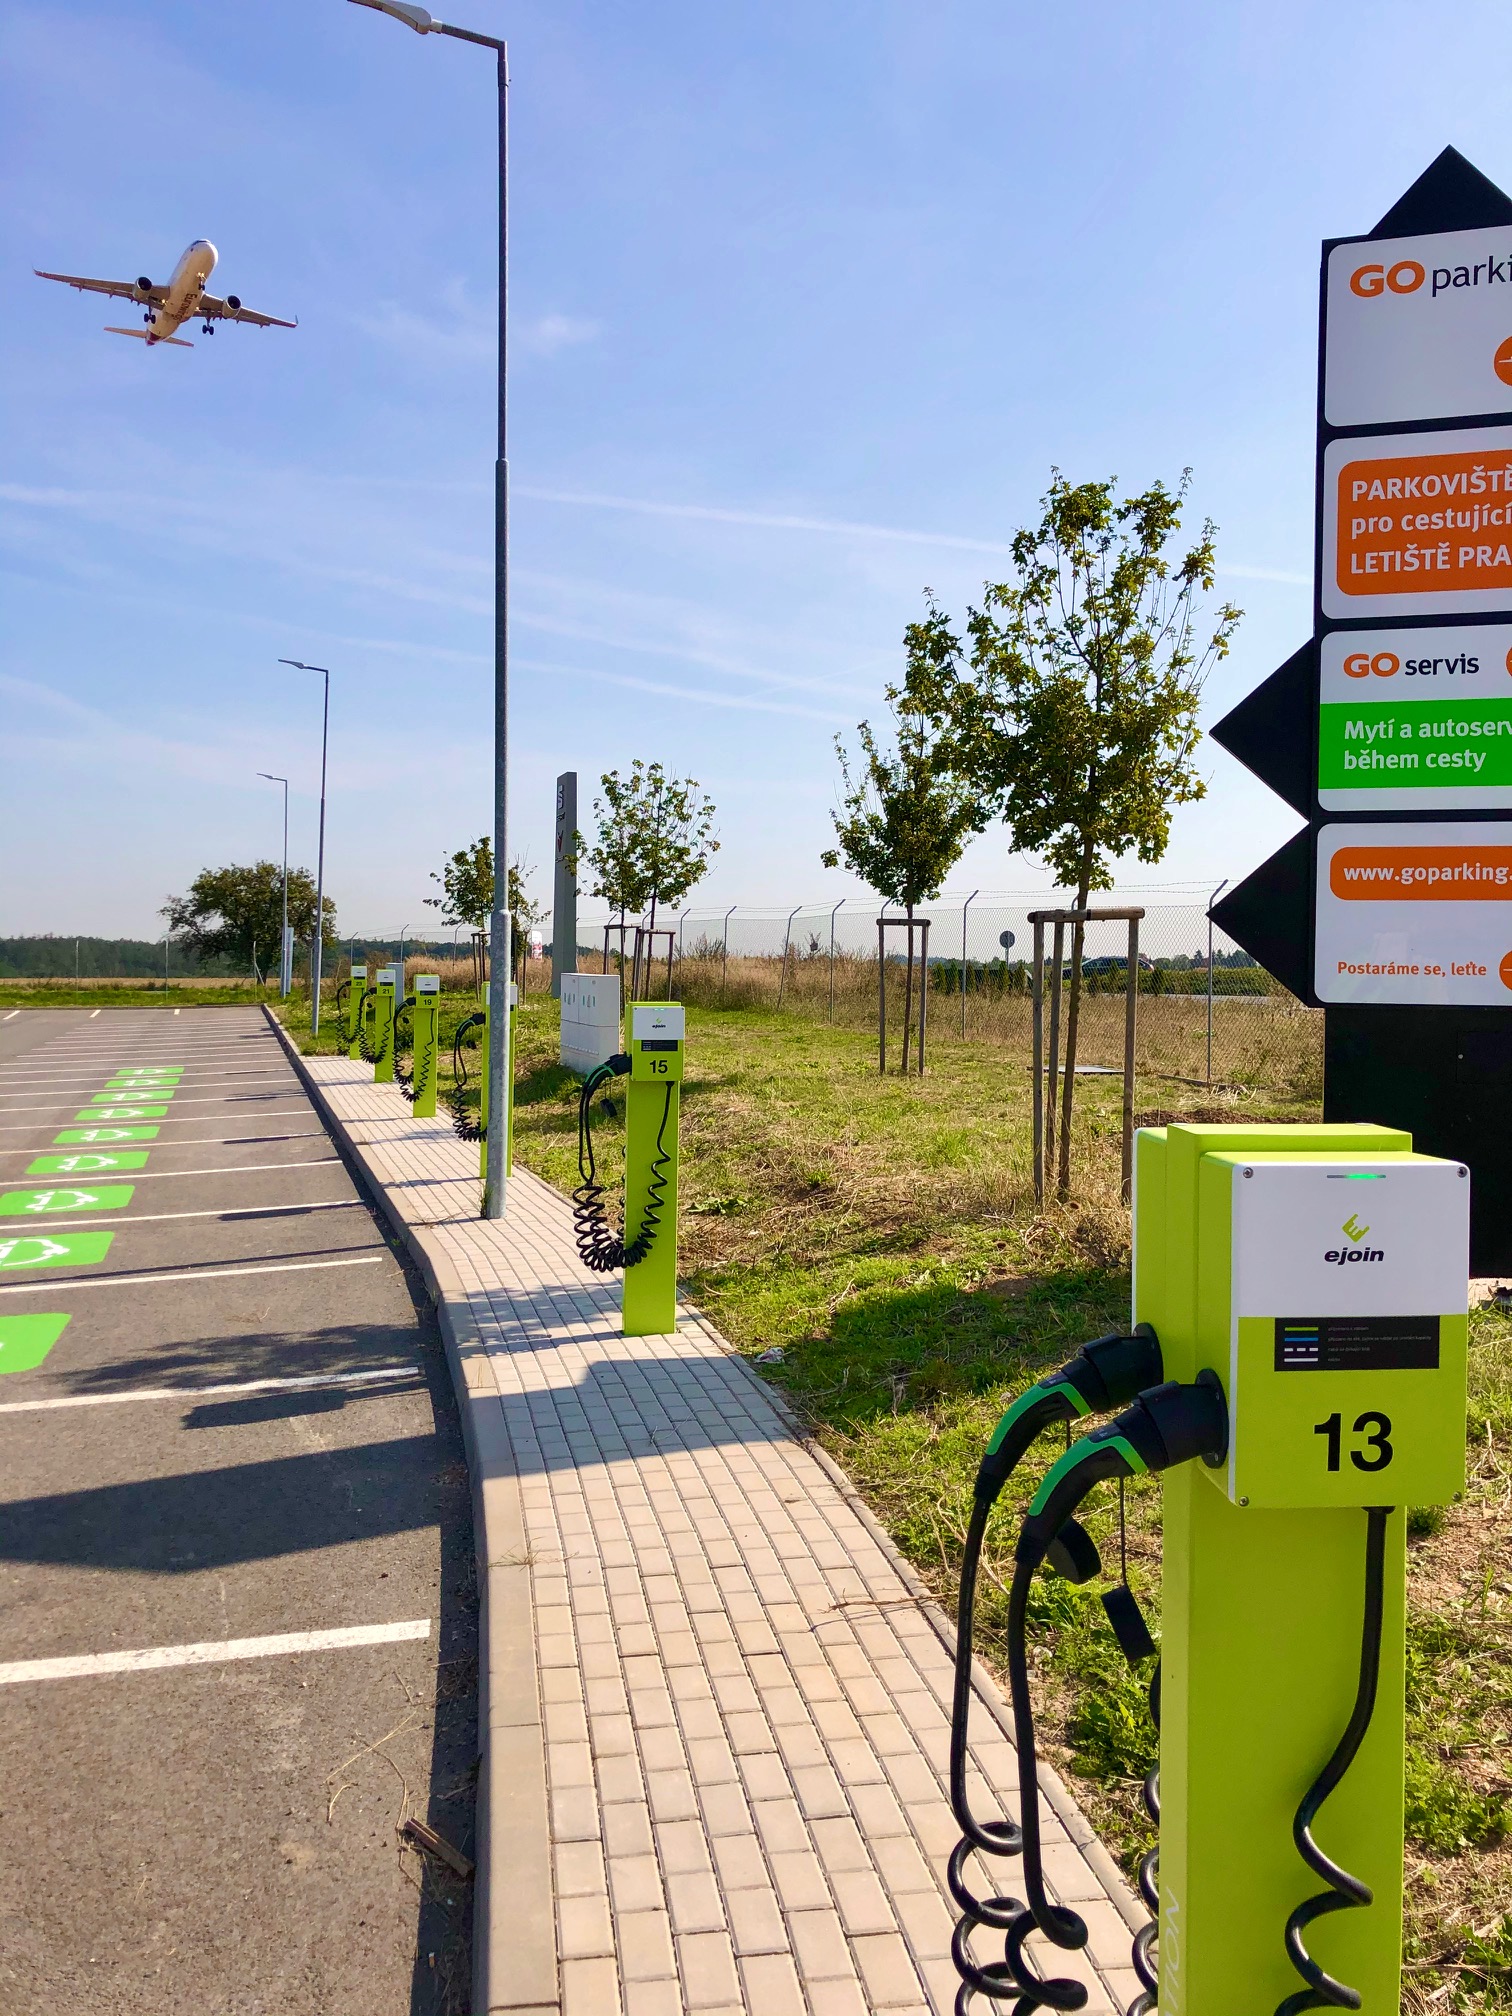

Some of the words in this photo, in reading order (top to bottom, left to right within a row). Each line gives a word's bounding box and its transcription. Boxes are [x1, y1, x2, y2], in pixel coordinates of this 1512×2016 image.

[1350, 260, 1425, 298] GO
[1351, 516, 1392, 539] pro
[1401, 503, 1512, 532] cestující
[1351, 541, 1450, 574] LETIŠTĚ
[1458, 544, 1512, 568] PRA
[1343, 652, 1400, 678] GO
[1405, 653, 1479, 676] servis
[1344, 718, 1395, 744] Mytí
[1400, 723, 1413, 738] a
[1344, 749, 1419, 770] během
[1426, 749, 1486, 772] cesty
[1337, 961, 1419, 976] Postaráme
[1424, 966, 1446, 977] se,
[1451, 961, 1487, 976] leťte
[649, 1060, 668, 1074] 15
[1324, 1247, 1384, 1265] ejoin
[1314, 1411, 1394, 1472] 13
